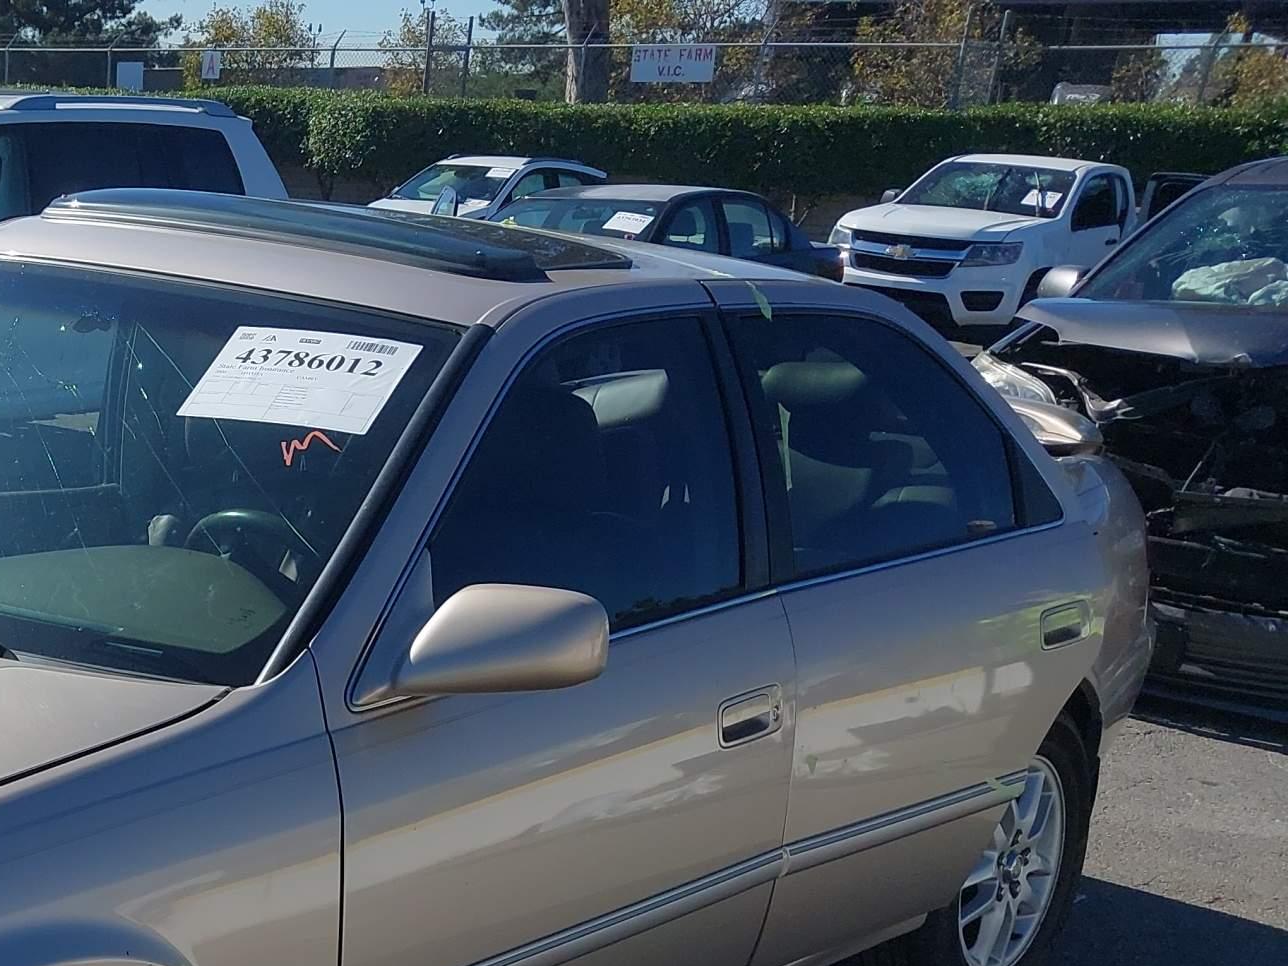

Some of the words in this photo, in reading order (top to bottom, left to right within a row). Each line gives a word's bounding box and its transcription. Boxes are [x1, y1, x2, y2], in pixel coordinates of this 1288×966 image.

[633, 48, 672, 62] STATE
[679, 48, 713, 61] FARM
[206, 54, 216, 75] A
[657, 65, 685, 77] V.I.C.
[235, 347, 383, 376] 43786012
[259, 365, 295, 374] Insurance
